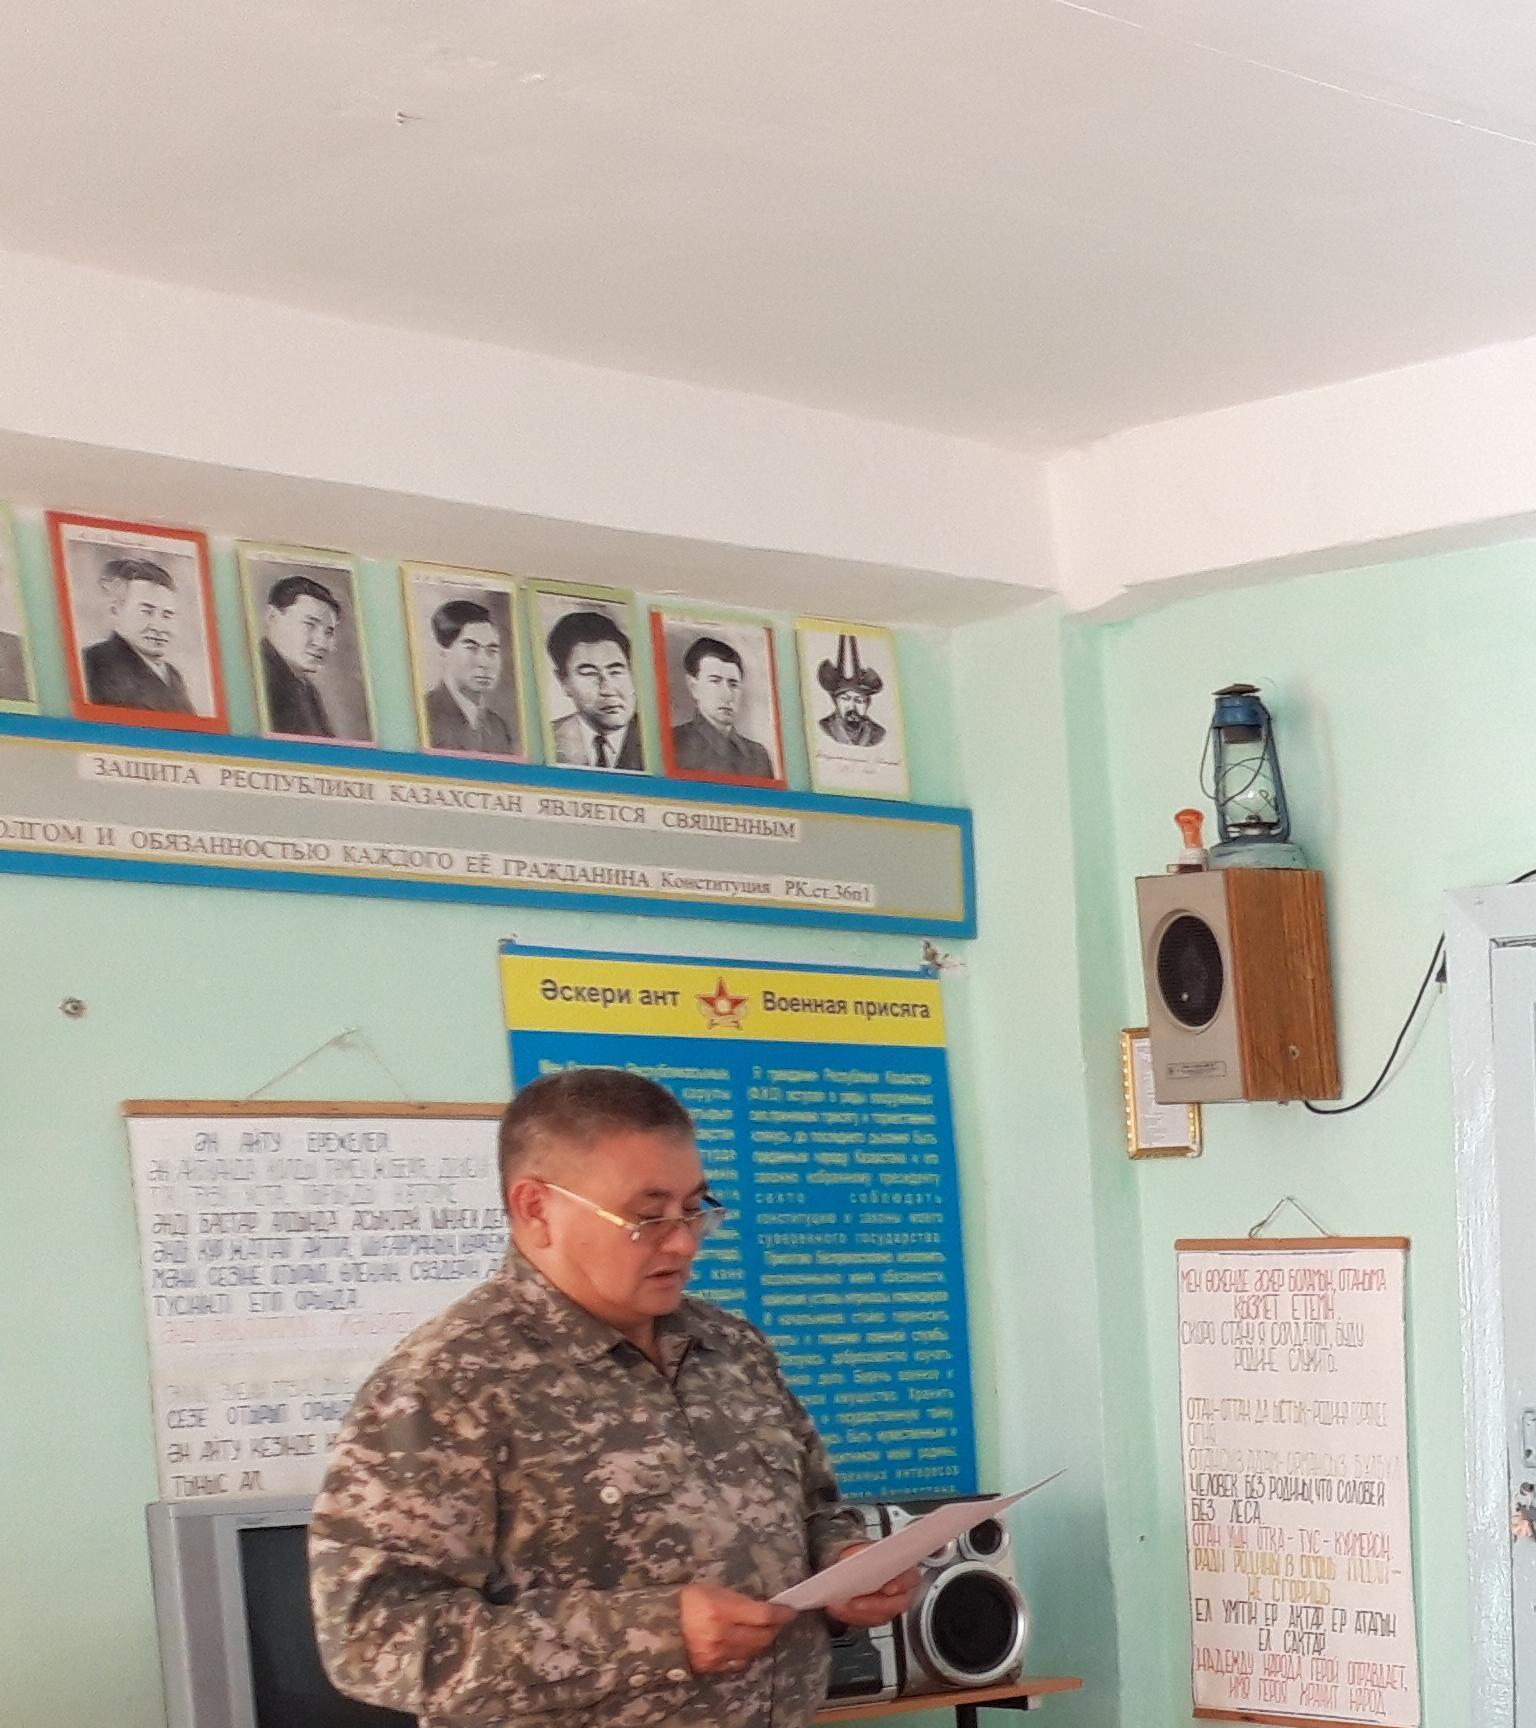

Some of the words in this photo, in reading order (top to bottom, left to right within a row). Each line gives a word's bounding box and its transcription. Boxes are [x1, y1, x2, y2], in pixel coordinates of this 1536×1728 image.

[93, 758, 200, 786] ЗАЩИТА
[219, 769, 374, 801] РЕСПУБЛИКИ
[390, 784, 523, 813] КАЗАХСТАН
[537, 799, 646, 824] ЯВЛЯЕТСЯ
[662, 810, 796, 839] СВЯЩЕННЫМ
[97, 826, 113, 845] И
[131, 830, 329, 861] ОБЯЗАННОСТЬЮ
[343, 845, 453, 870] КАЖДОГО
[466, 851, 491, 873] ЕЁ
[503, 858, 649, 889] ГРАЖДАНИНА
[661, 872, 770, 897] Конституция
[541, 978, 632, 1008] Әскери
[640, 987, 680, 1007] ант
[762, 991, 847, 1016] Военная
[854, 999, 930, 1020] присяга
